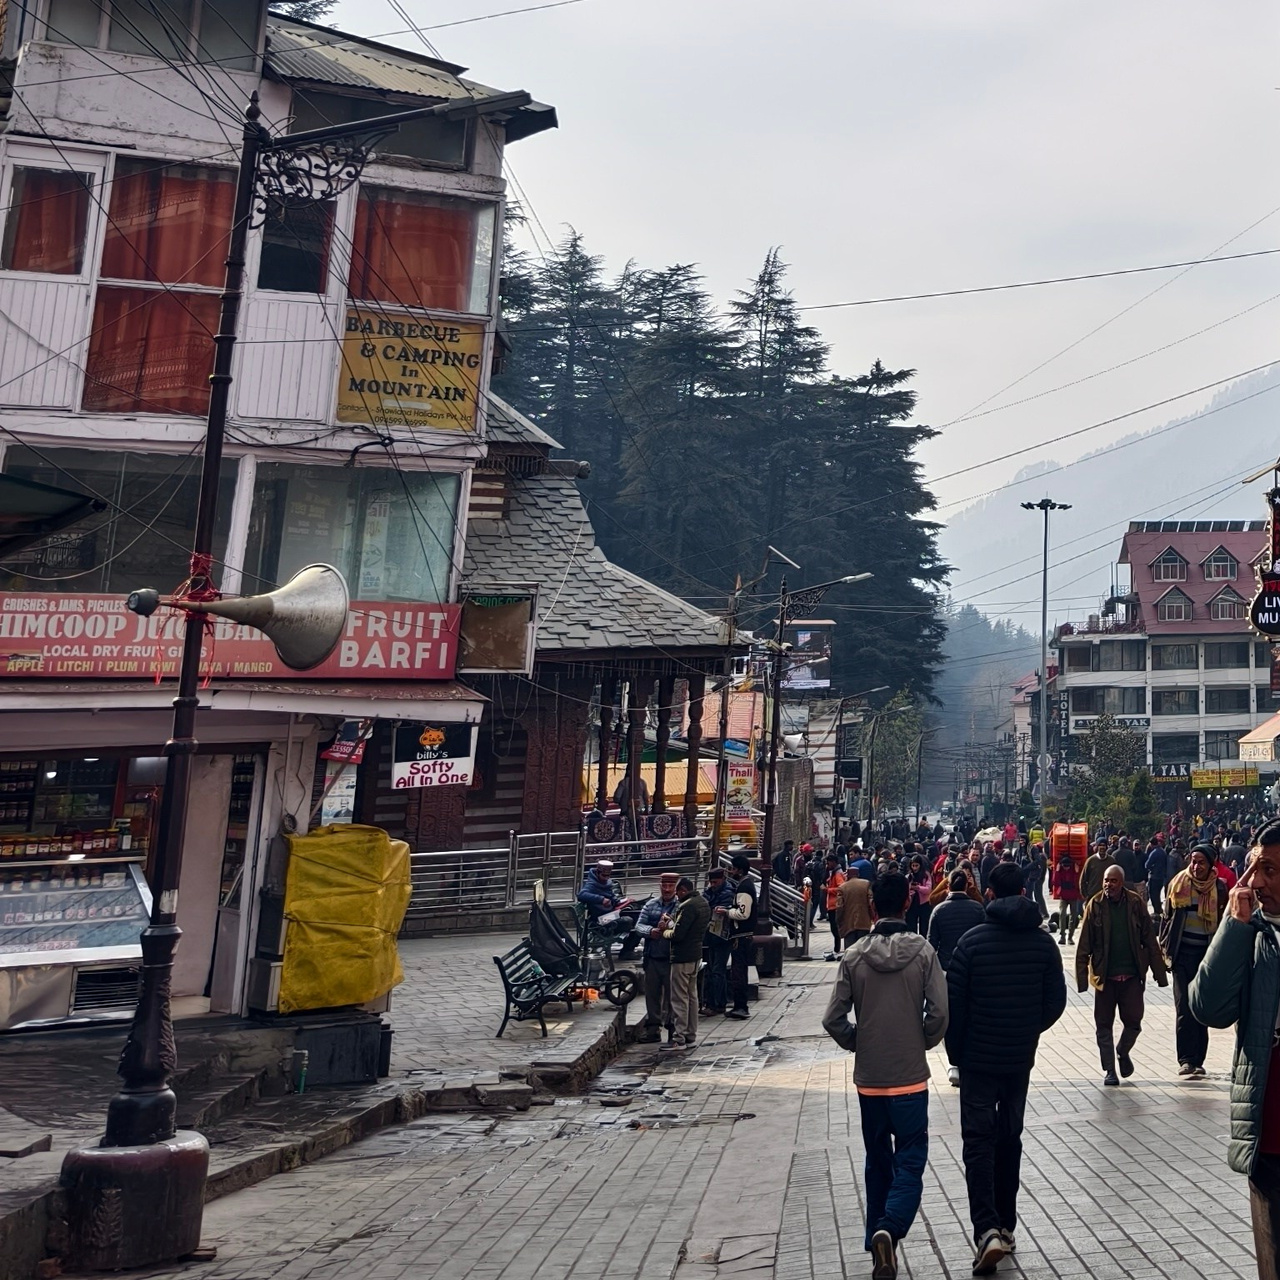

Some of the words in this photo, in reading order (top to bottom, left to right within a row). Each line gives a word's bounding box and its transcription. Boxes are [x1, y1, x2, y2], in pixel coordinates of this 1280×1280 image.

[346, 316, 461, 344] BARBECUE
[360, 342, 377, 358] &
[383, 344, 481, 369] CAMPING
[401, 365, 419, 378] In
[348, 377, 467, 402] MOUNTAIN
[2, 597, 48, 612] CRUSHES
[49, 600, 57, 612] &
[346, 610, 449, 639] FRUIT
[43, 644, 91, 658] LOCAL
[92, 645, 122, 658] DRY
[123, 645, 165, 658] FRUIT
[167, 646, 208, 658] GIS
[7, 660, 45, 673] APPLE
[56, 660, 94, 673] LITCHI
[106, 660, 138, 673] PLUM
[233, 661, 273, 674] MANGO
[1060, 692, 1069, 738] HOTEL
[1125, 718, 1148, 727] YAK
[416, 750, 449, 761] billy's
[1060, 749, 1069, 777] YAK
[409, 760, 455, 776] Softy
[728, 768, 753, 778] Thali
[1161, 764, 1188, 776] YAK
[395, 775, 415, 788] All
[419, 774, 433, 786] In
[437, 772, 469, 784] One
